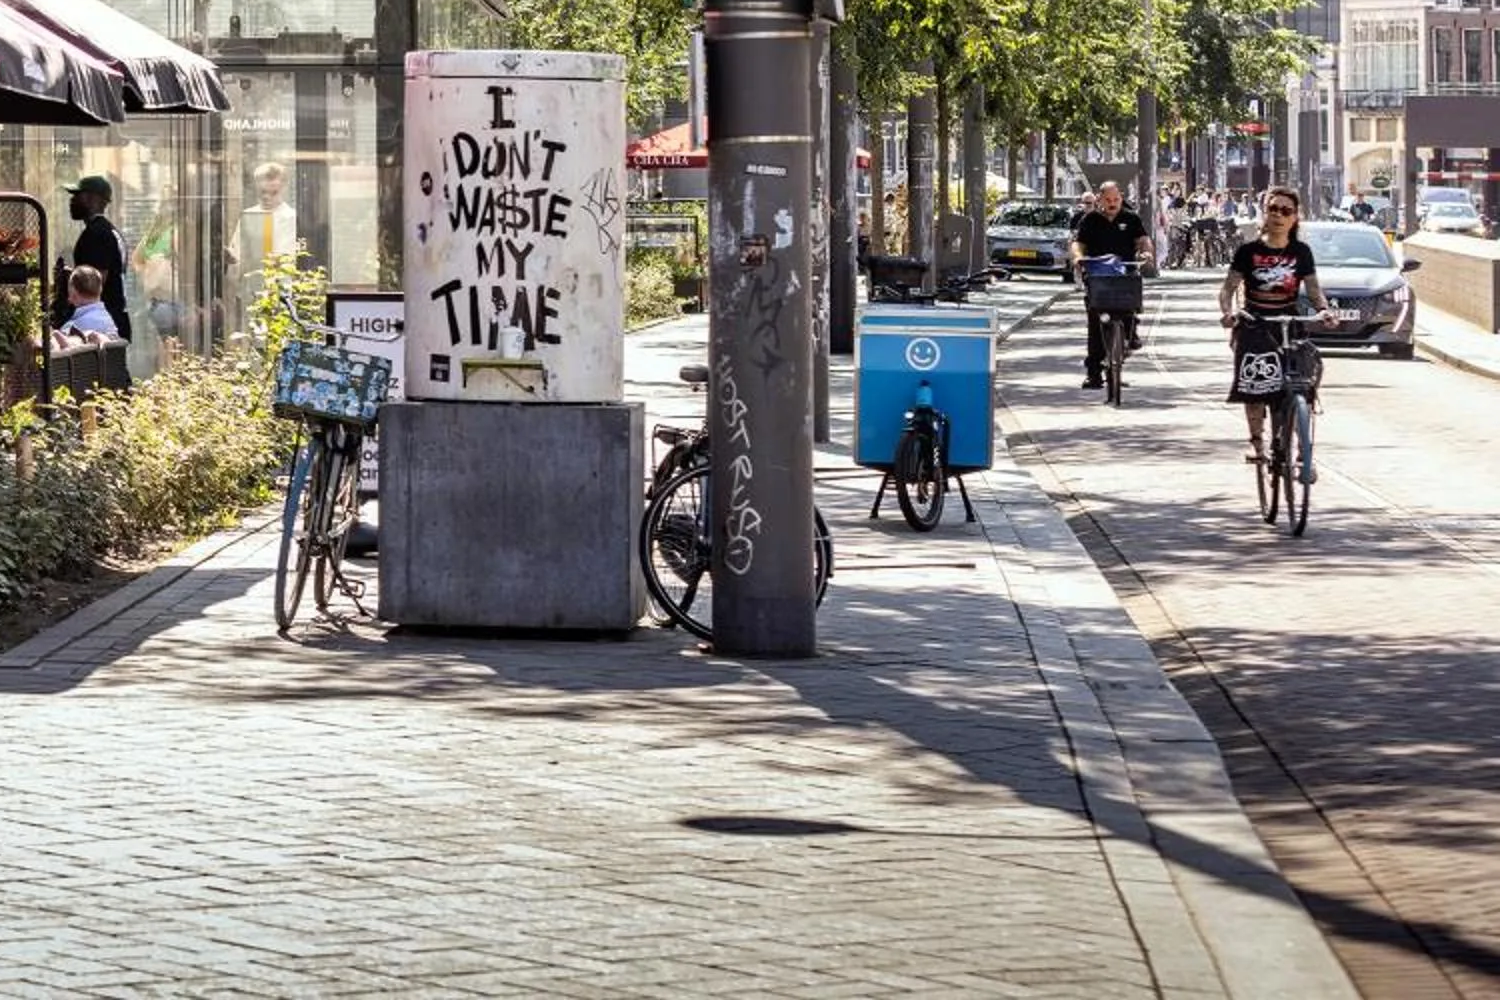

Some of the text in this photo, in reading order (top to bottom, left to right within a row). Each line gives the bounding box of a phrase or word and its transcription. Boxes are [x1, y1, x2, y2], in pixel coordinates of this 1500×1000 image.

[485, 85, 516, 129] I
[452, 130, 567, 181] DON'T
[476, 236, 534, 281] MY
[431, 279, 562, 352] TIME
